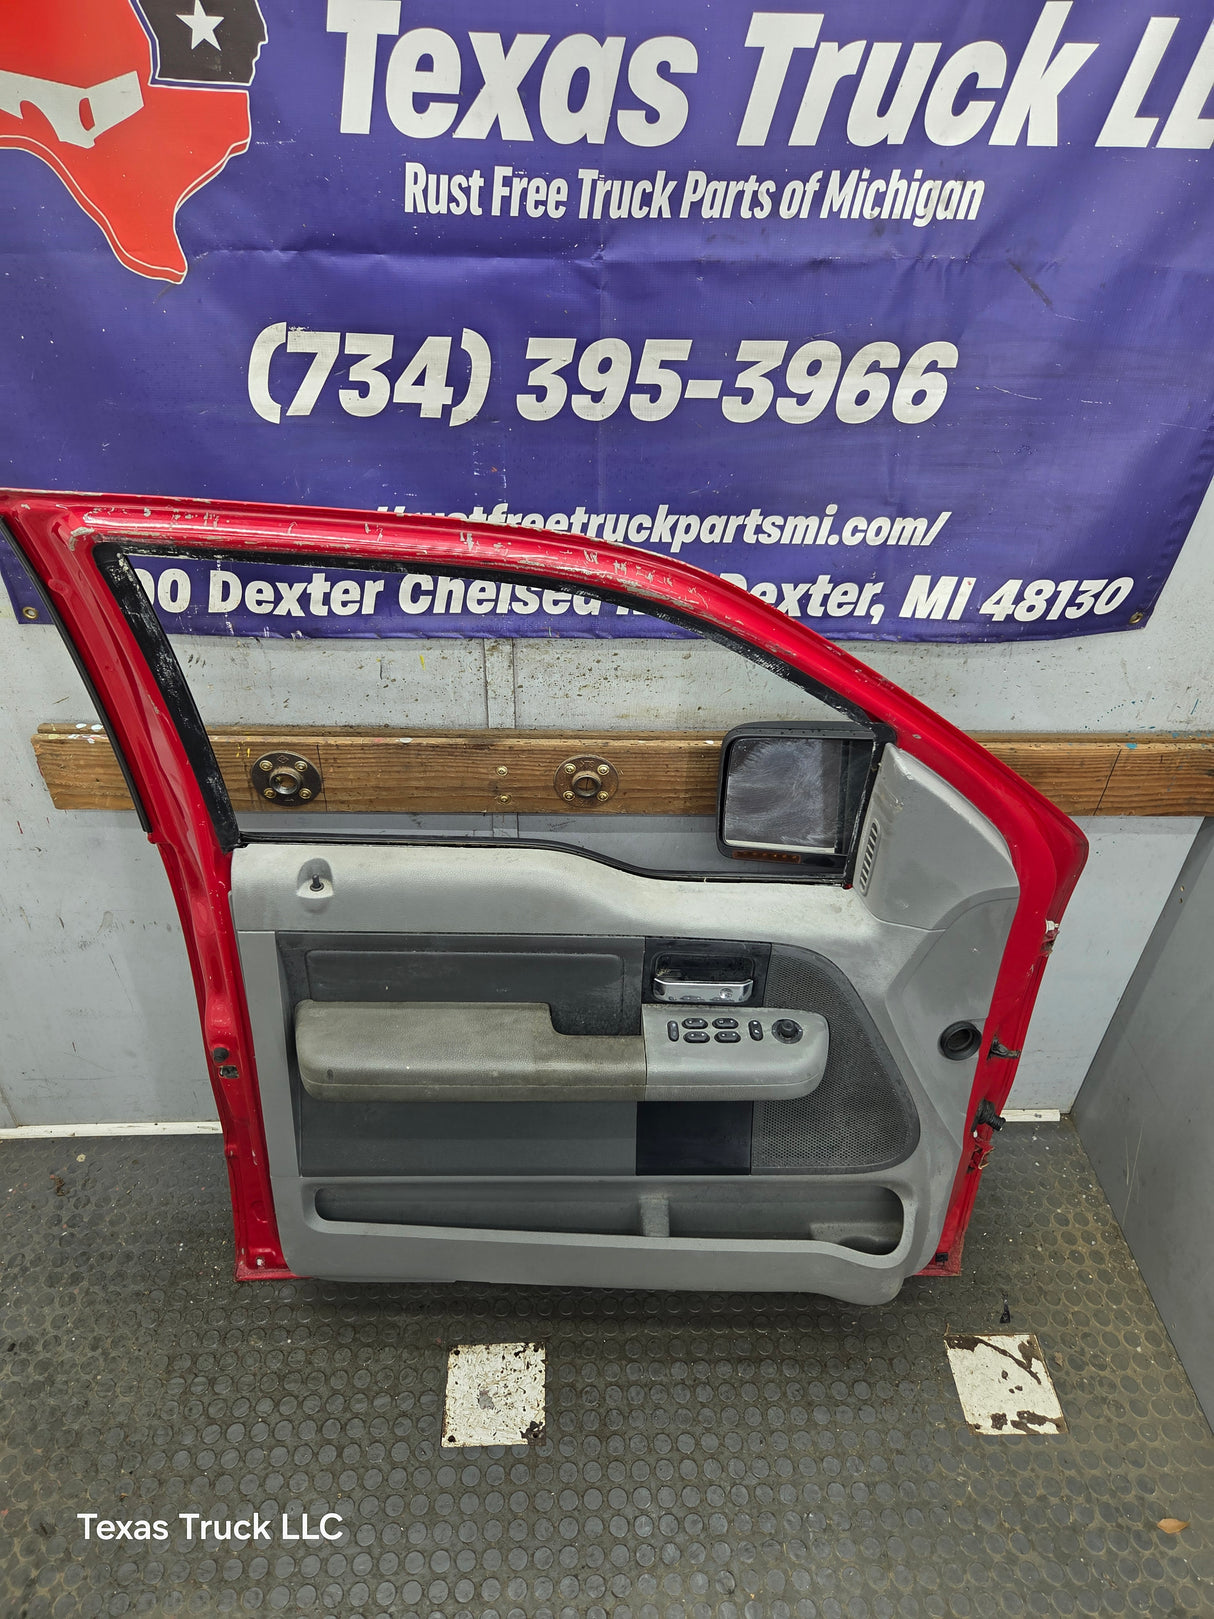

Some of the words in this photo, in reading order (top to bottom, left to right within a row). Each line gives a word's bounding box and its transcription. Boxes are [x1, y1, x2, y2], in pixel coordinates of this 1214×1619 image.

[326, 0, 698, 147] Texas
[736, 0, 1099, 147] Truck
[404, 162, 484, 216] Rust
[491, 165, 568, 218] Free
[578, 168, 677, 219] Truck
[680, 170, 776, 219] Parts
[779, 170, 823, 219] of
[820, 169, 985, 227] Michigan
[248, 322, 492, 427] (734)
[516, 337, 959, 424] 395-3966
[208, 569, 385, 616] Dexter
[899, 574, 977, 621] MI
[979, 577, 1134, 622] 48130
